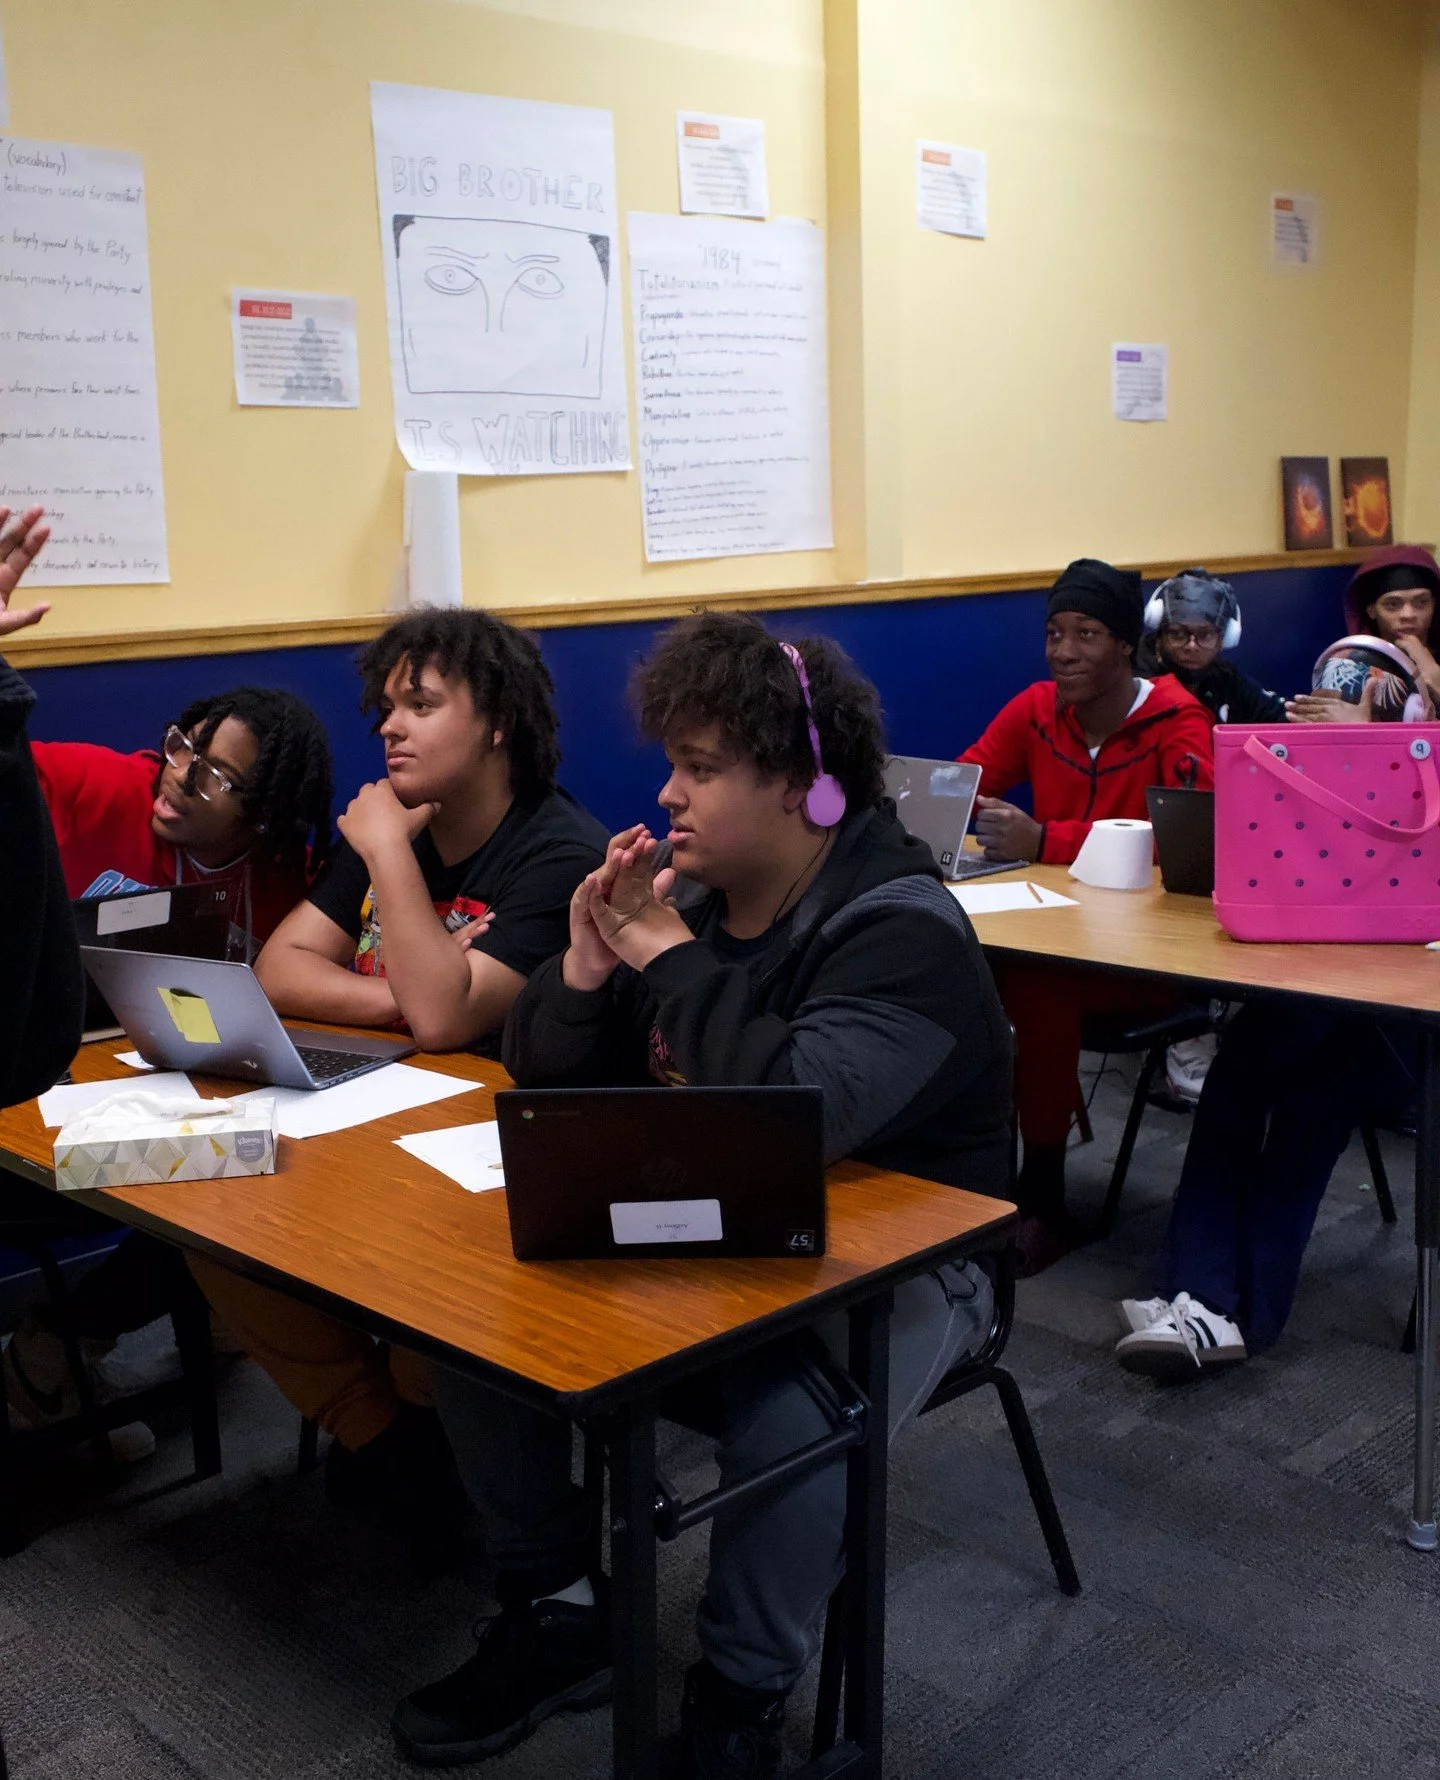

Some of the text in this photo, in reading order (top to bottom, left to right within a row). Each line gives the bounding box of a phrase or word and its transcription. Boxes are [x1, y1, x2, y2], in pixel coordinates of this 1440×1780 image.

[390, 155, 606, 214] BIG BROTHER
[105, 239, 132, 265] Party
[703, 246, 741, 274] 1984
[403, 410, 630, 466] IS WATCHING
[215, 891, 226, 901] 10
[790, 1234, 809, 1246] 57
